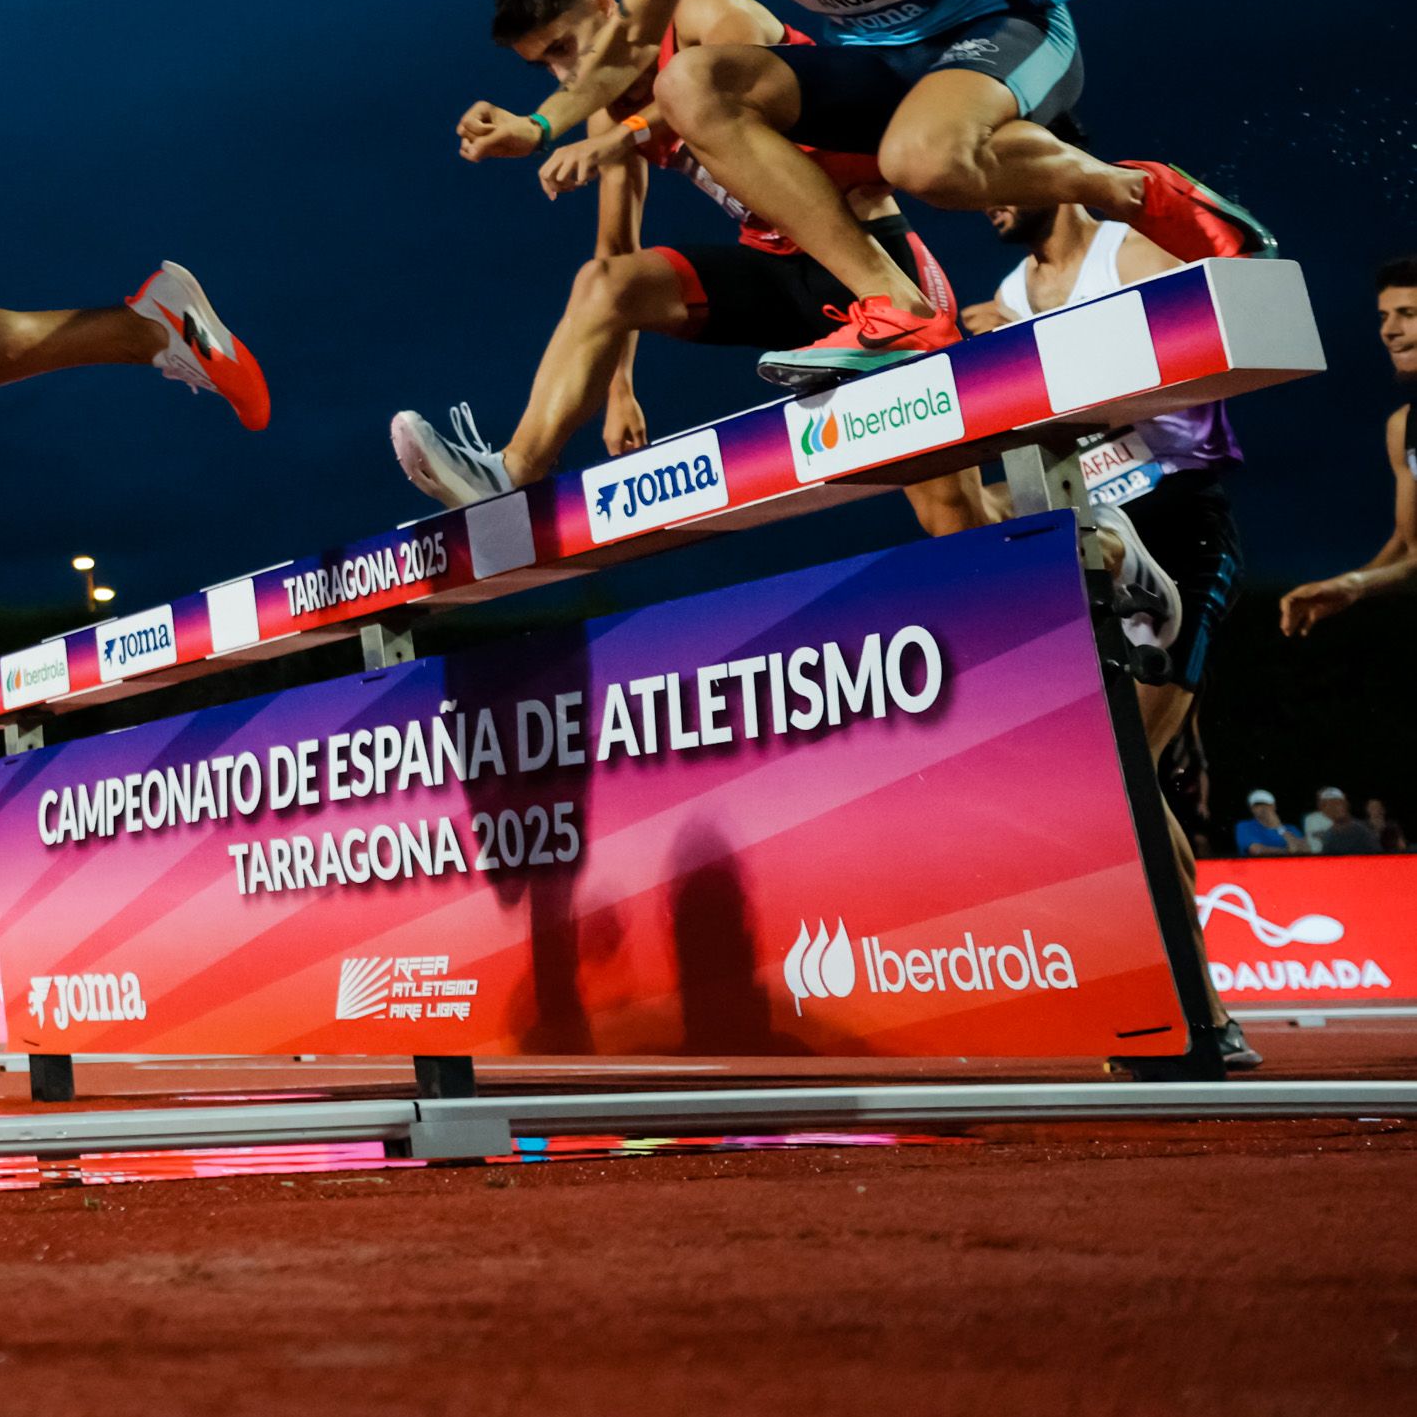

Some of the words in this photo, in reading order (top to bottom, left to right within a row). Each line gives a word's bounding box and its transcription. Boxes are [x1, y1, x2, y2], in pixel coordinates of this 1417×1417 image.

[842, 384, 953, 442] Iberdrola
[284, 546, 400, 615] TARRAGONA
[401, 532, 448, 583] 2025
[23, 659, 67, 686] Iberdrola
[38, 752, 259, 846] CAMPEONATO
[269, 742, 320, 811] DE
[328, 700, 507, 800] ESPAÑA
[517, 691, 585, 772] DE
[597, 625, 944, 762] ATLETISMO
[229, 816, 467, 897] TARRAGONA
[473, 801, 580, 872] 2025
[394, 955, 449, 981] RFEA
[861, 929, 1079, 995] Iberdrola
[1208, 959, 1392, 992] DAURADA
[392, 979, 478, 998] ATLETISMO
[389, 1003, 422, 1022] AIRE
[426, 1002, 470, 1021] LIBRE
